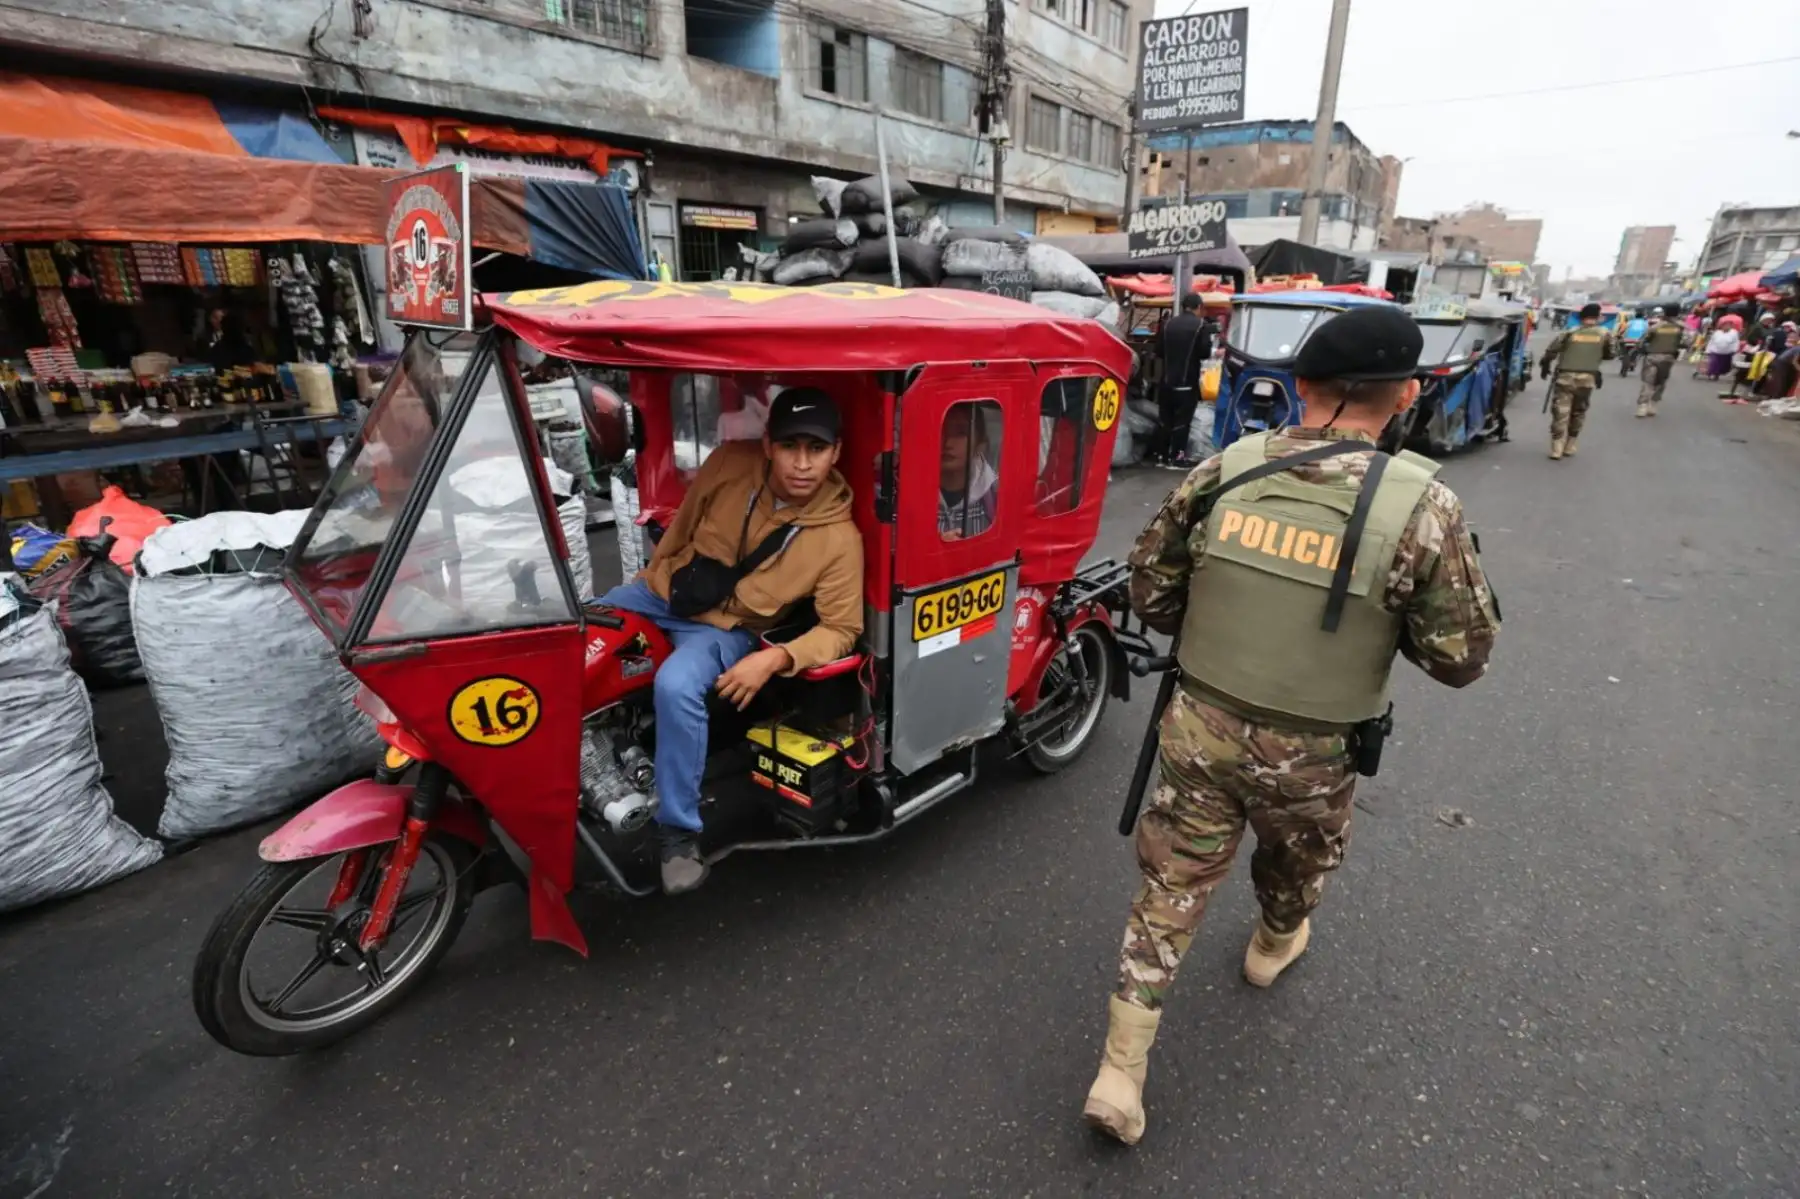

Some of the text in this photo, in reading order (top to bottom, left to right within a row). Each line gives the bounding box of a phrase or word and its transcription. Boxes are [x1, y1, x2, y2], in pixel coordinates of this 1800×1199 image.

[1144, 12, 1233, 49] CARBON
[1143, 39, 1240, 67] ALGARROBO
[1143, 65, 1167, 84] POR
[1168, 60, 1202, 81] MAYOR
[1143, 85, 1151, 101] Y
[1154, 80, 1183, 100] LEÑA
[1128, 201, 1226, 235] ALGARROBO
[413, 227, 427, 261] 16
[470, 687, 529, 737] 16
